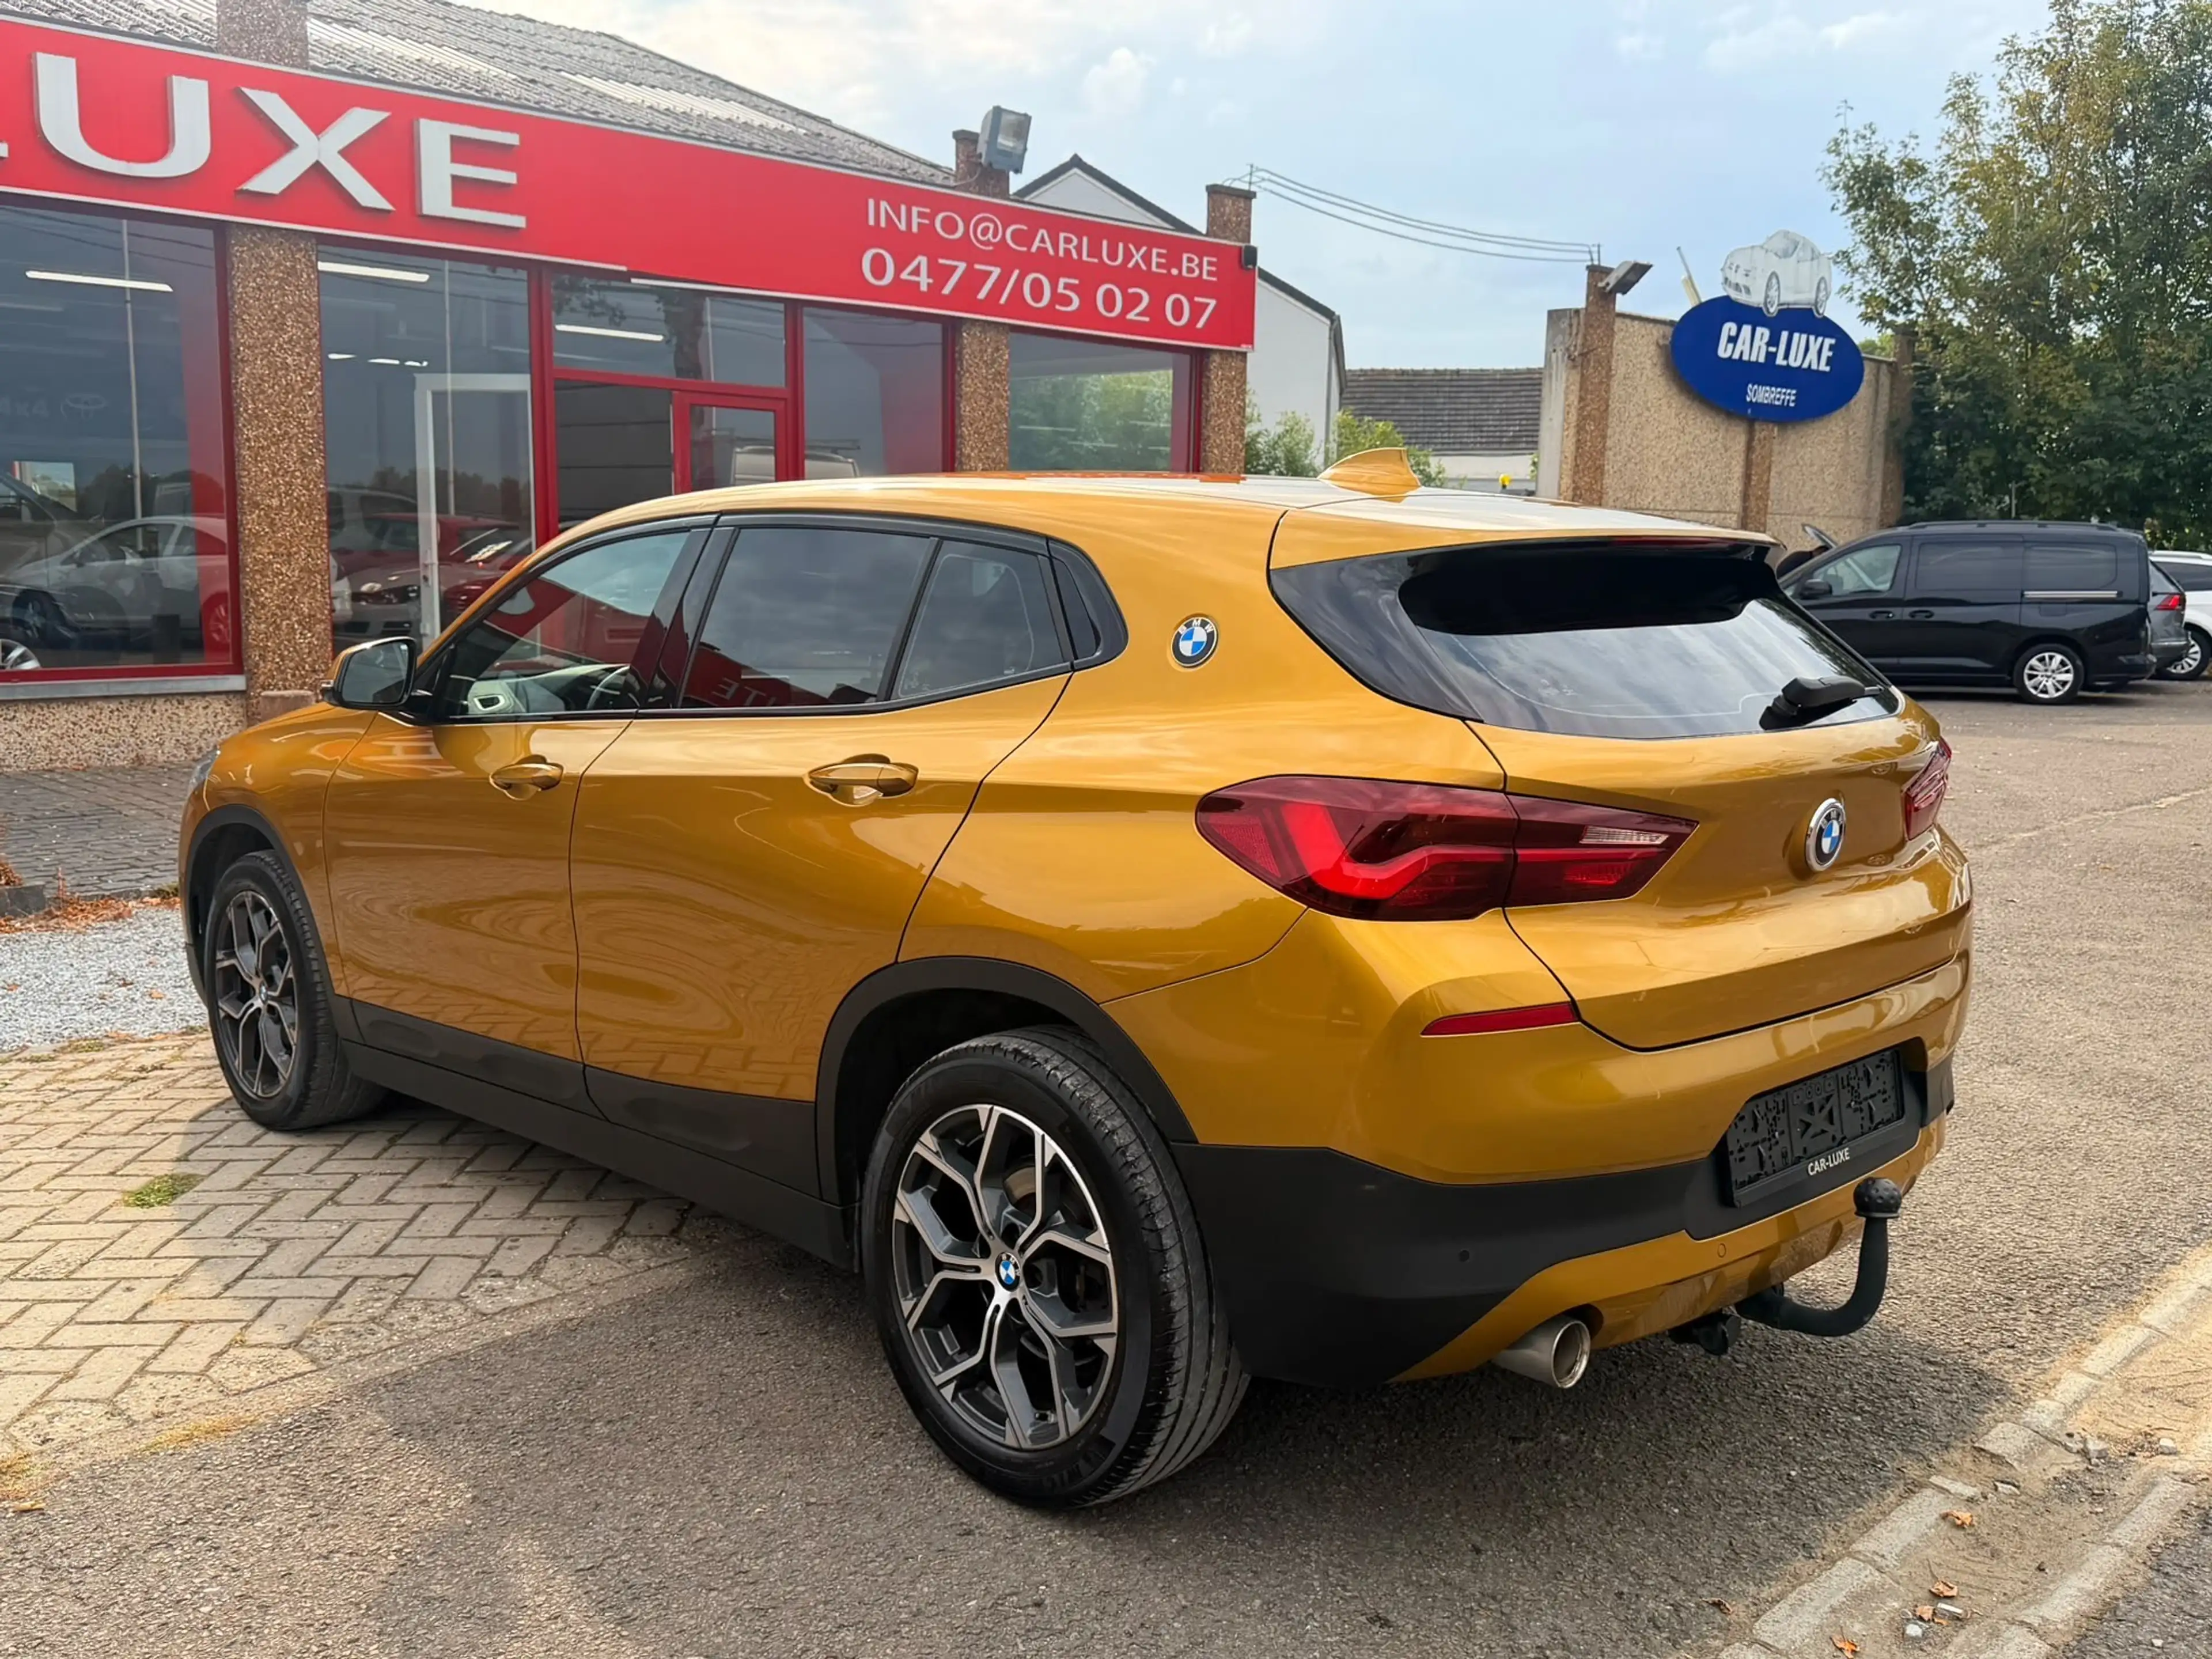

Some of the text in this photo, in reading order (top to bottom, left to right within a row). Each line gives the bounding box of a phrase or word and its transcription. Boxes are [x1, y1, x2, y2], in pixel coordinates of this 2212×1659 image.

[0, 52, 527, 229] UXE
[867, 198, 1218, 282] INFO@CARLUXE.BE
[861, 248, 1218, 329] 0477/05 02 07
[1717, 321, 1836, 373] CAR-LUXE
[1745, 383, 1797, 407] SOMBREFFE
[1807, 1147, 1850, 1176] CAR-LUXE
